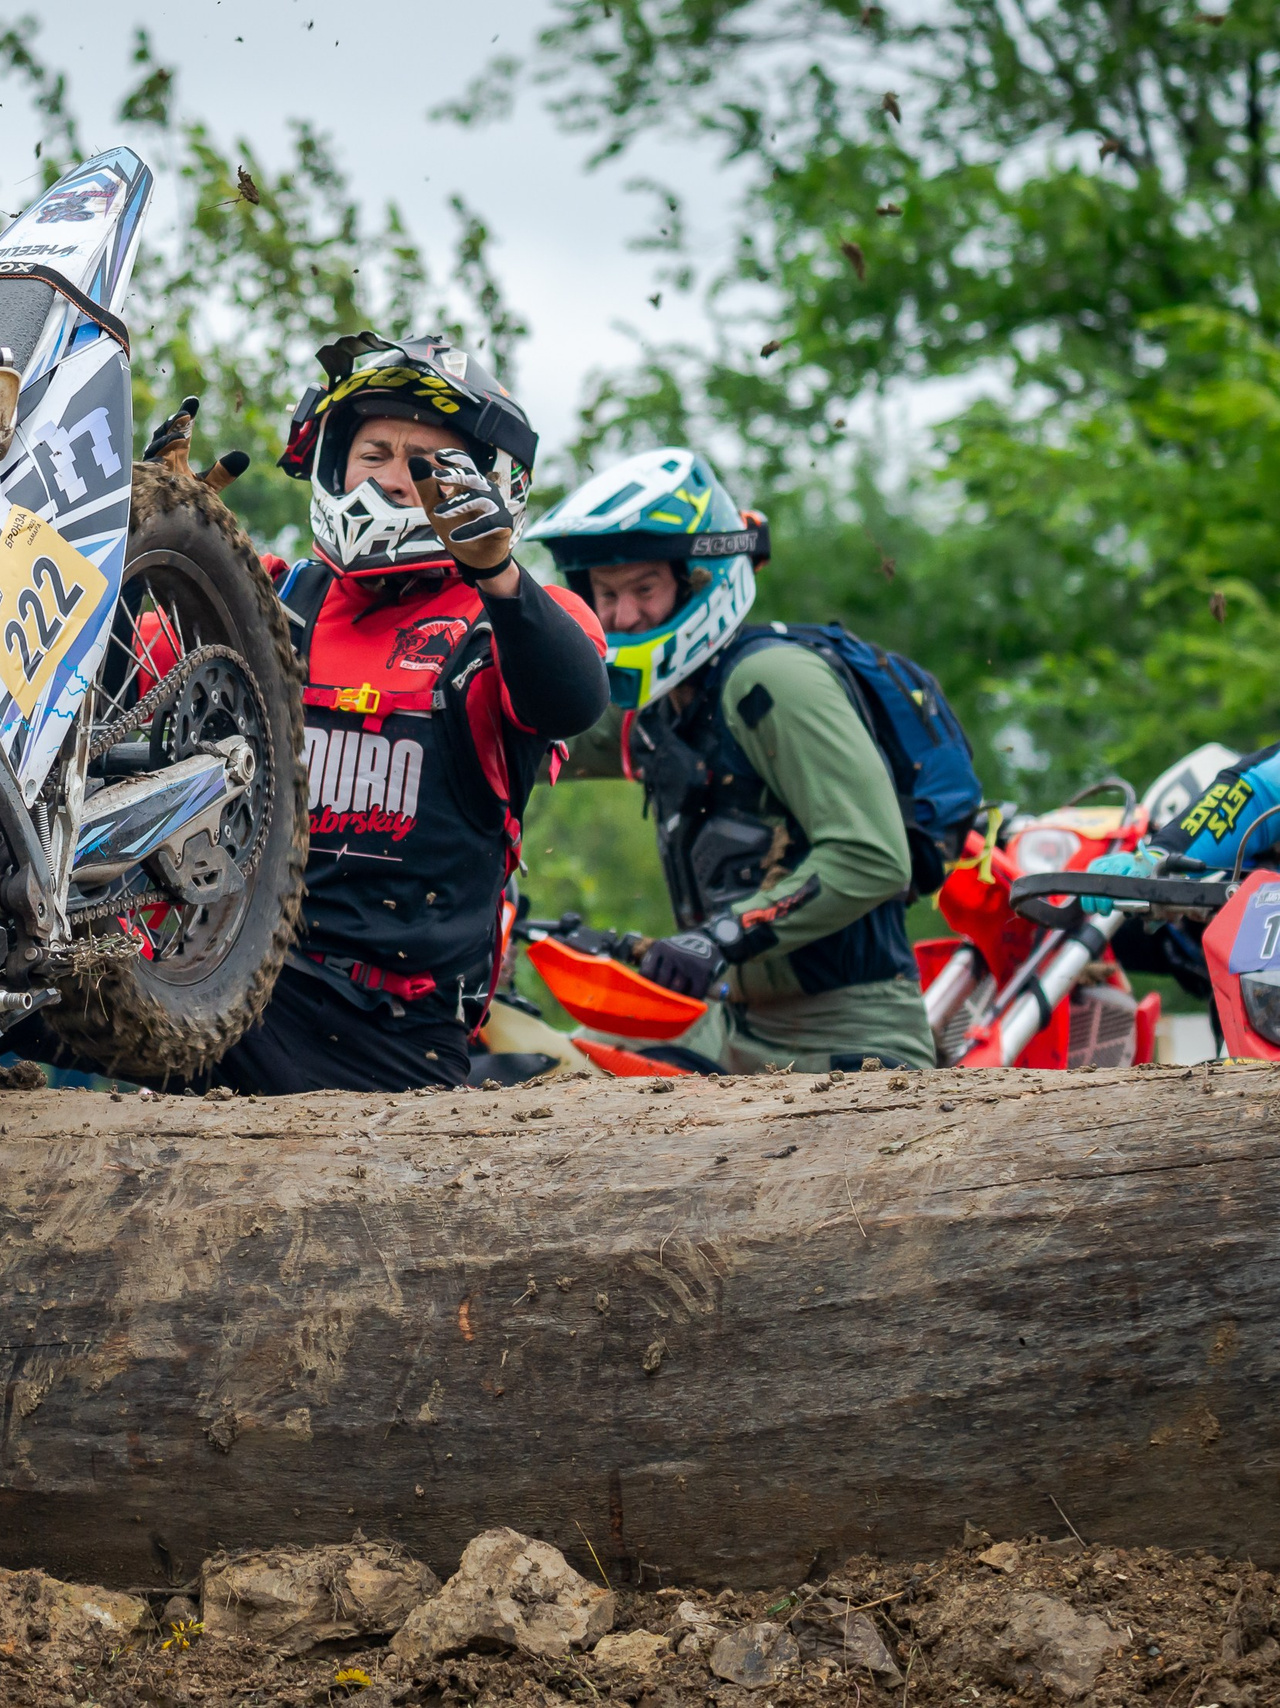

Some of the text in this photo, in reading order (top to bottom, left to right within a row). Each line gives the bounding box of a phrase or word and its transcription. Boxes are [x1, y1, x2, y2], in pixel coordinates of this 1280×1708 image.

[4, 512, 28, 549] БРОНЗА
[5, 556, 85, 684] 222
[304, 726, 424, 823] DURO
[308, 804, 418, 841] abrskiy
[1180, 783, 1231, 837] RACE
